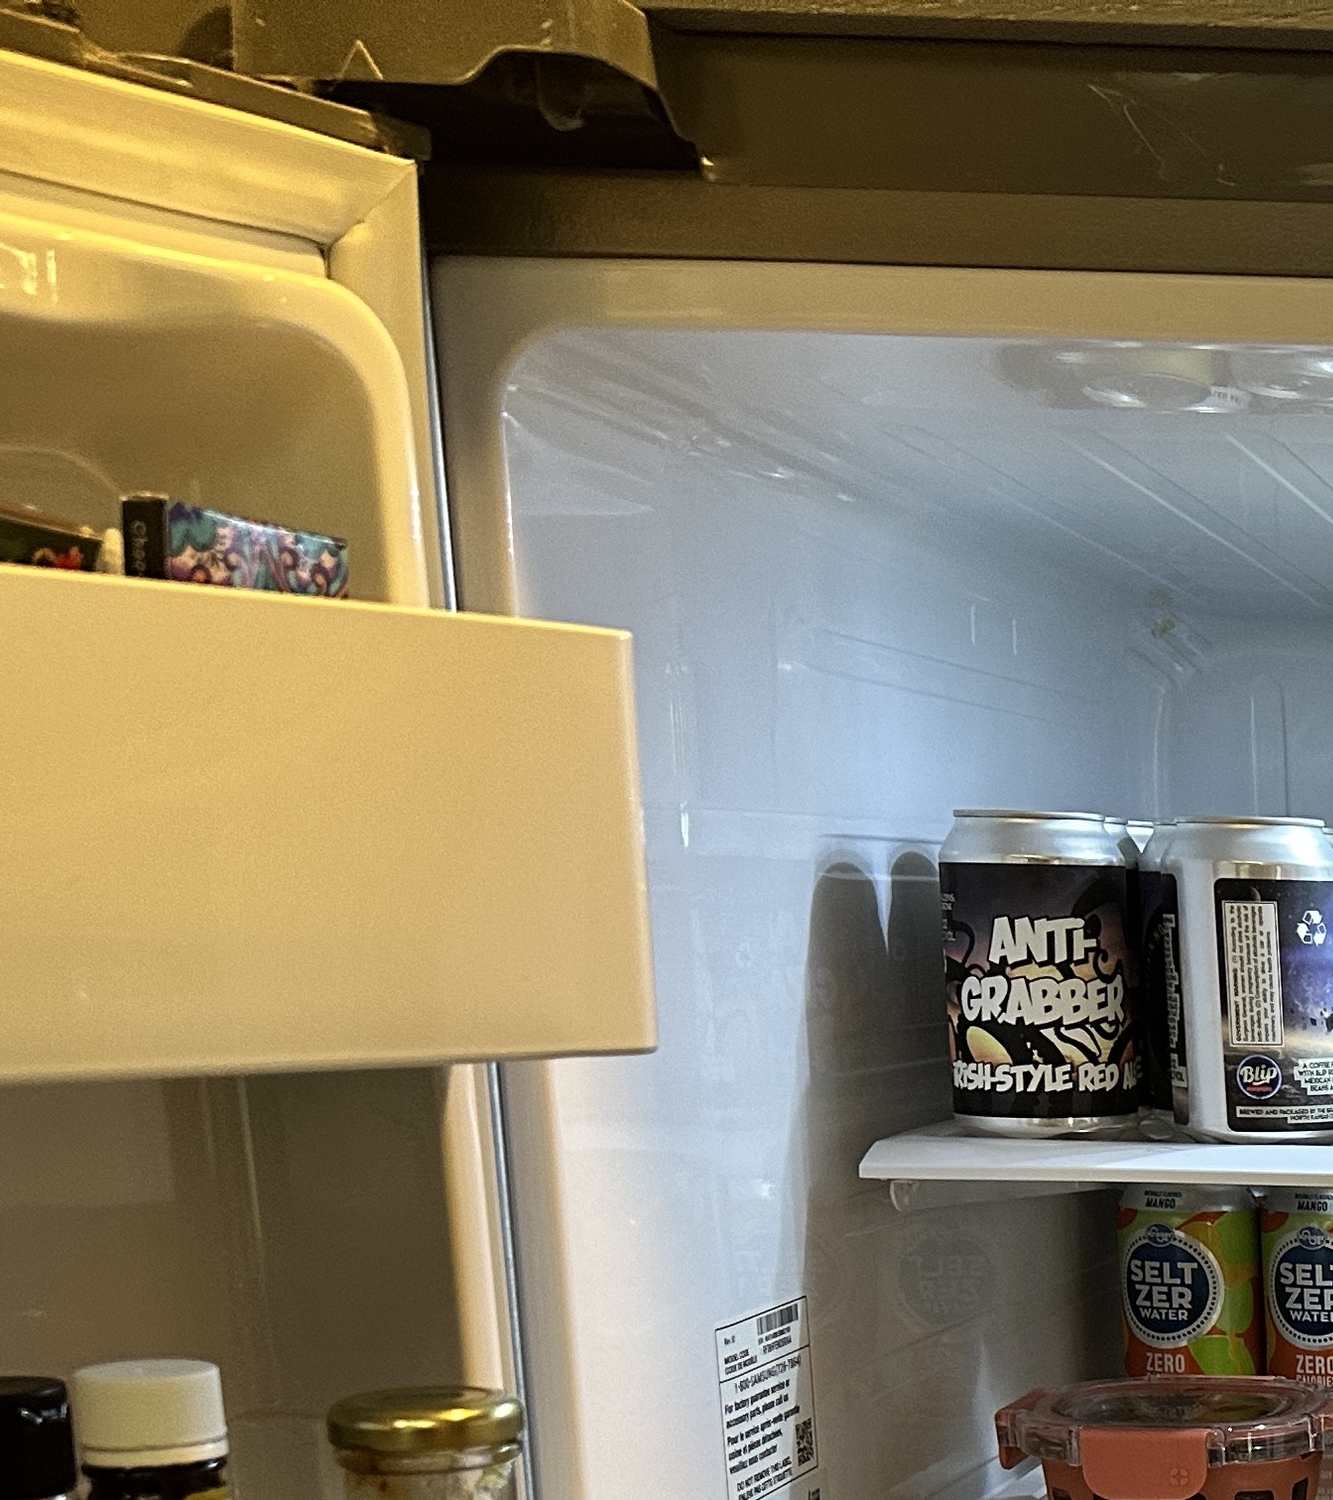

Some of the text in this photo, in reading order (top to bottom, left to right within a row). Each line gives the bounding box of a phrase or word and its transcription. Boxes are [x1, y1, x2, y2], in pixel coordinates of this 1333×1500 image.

[961, 974, 1125, 1026] GRABBER
[954, 1060, 1074, 1093] RISH-STYLE
[1078, 1063, 1119, 1093] RED
[1239, 1065, 1277, 1085] Blip
[1145, 1197, 1177, 1209] MANGO
[1297, 1200, 1329, 1212] MANGO
[1130, 1260, 1198, 1285] SELT
[1135, 1284, 1193, 1309] ZER
[1139, 1308, 1189, 1321] WATER
[1146, 1352, 1186, 1373] ZERO
